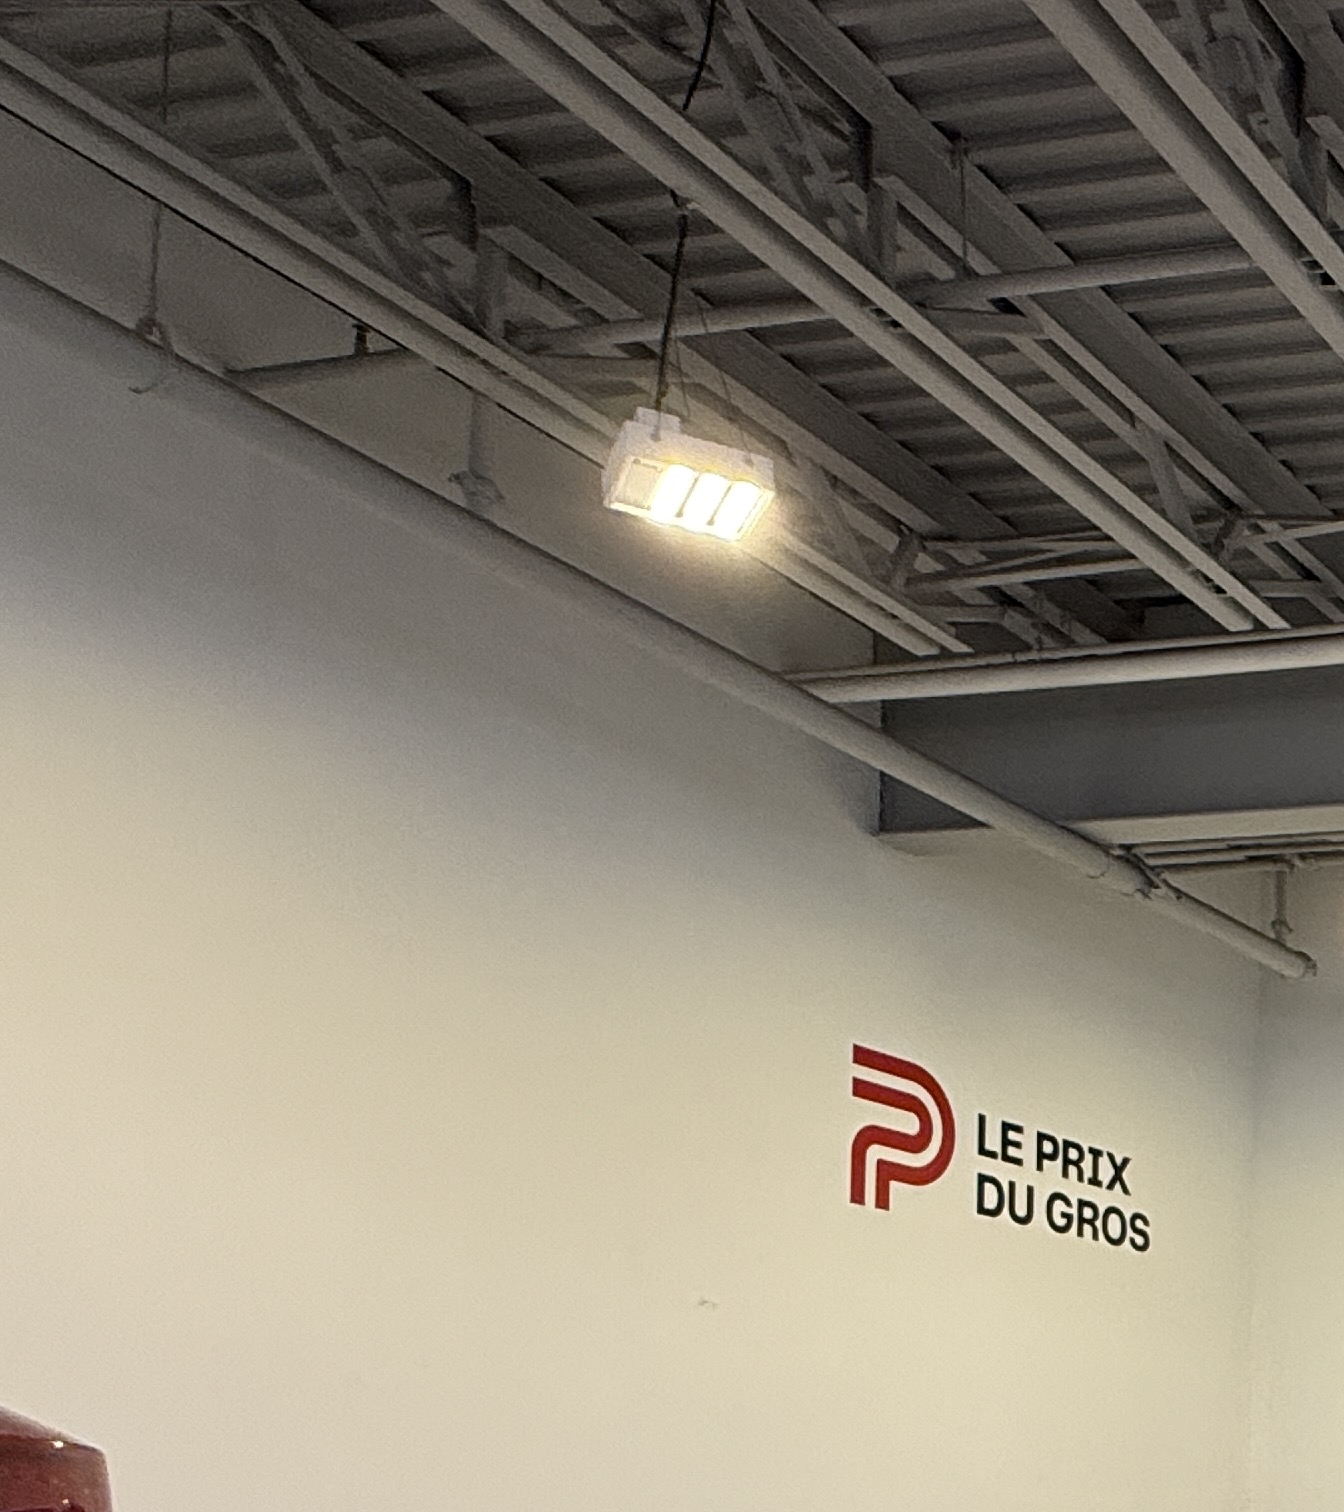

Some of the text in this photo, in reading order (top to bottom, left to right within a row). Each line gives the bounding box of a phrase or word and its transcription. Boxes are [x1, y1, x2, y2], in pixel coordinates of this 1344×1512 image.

[977, 1112, 1132, 1197] LE PRIX
[976, 1171, 1152, 1253] DU GROS
